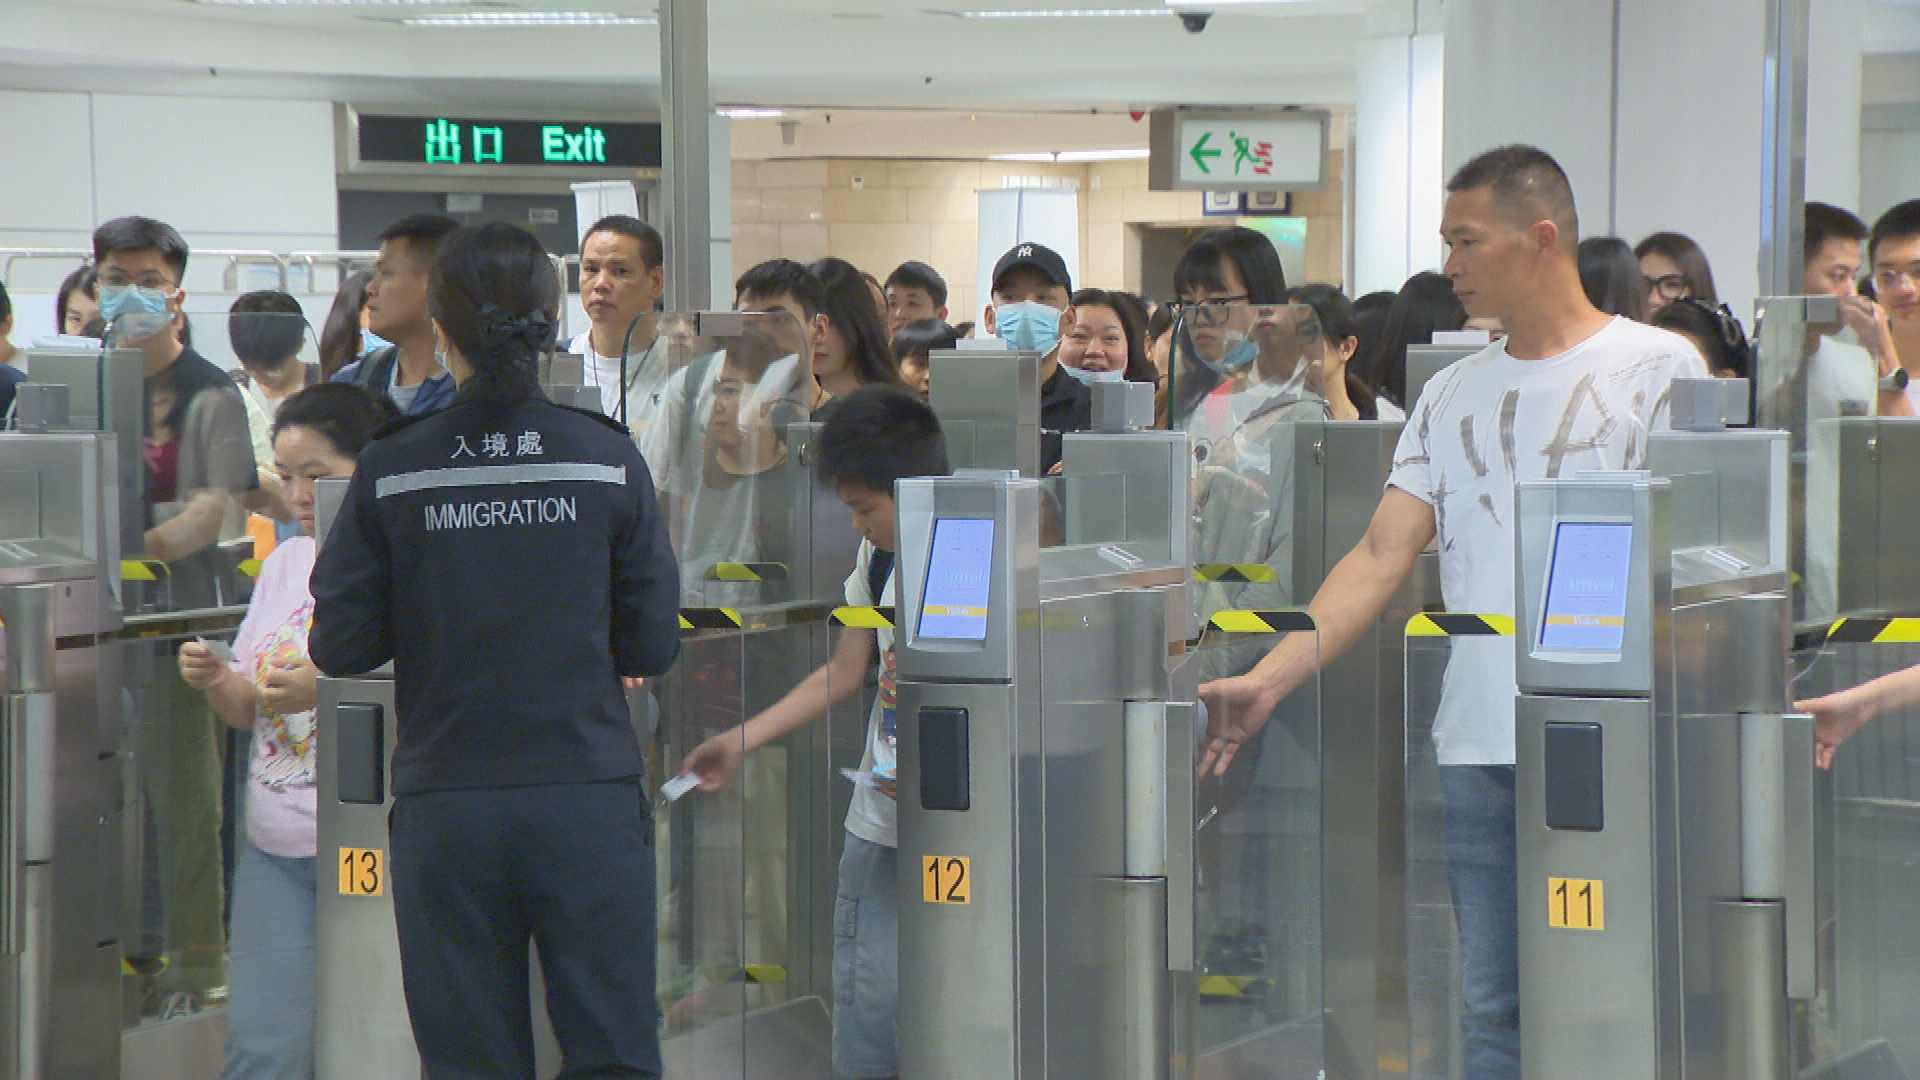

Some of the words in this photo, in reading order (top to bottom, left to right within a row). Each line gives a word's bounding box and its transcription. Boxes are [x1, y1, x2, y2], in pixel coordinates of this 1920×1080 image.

[425, 118, 503, 164] 出口
[542, 125, 606, 162] Exit
[450, 431, 543, 458] 入境處
[424, 496, 576, 530] IMMIGRATION
[344, 850, 378, 894] 13
[929, 857, 966, 902] 12
[1556, 880, 1592, 927] 11
